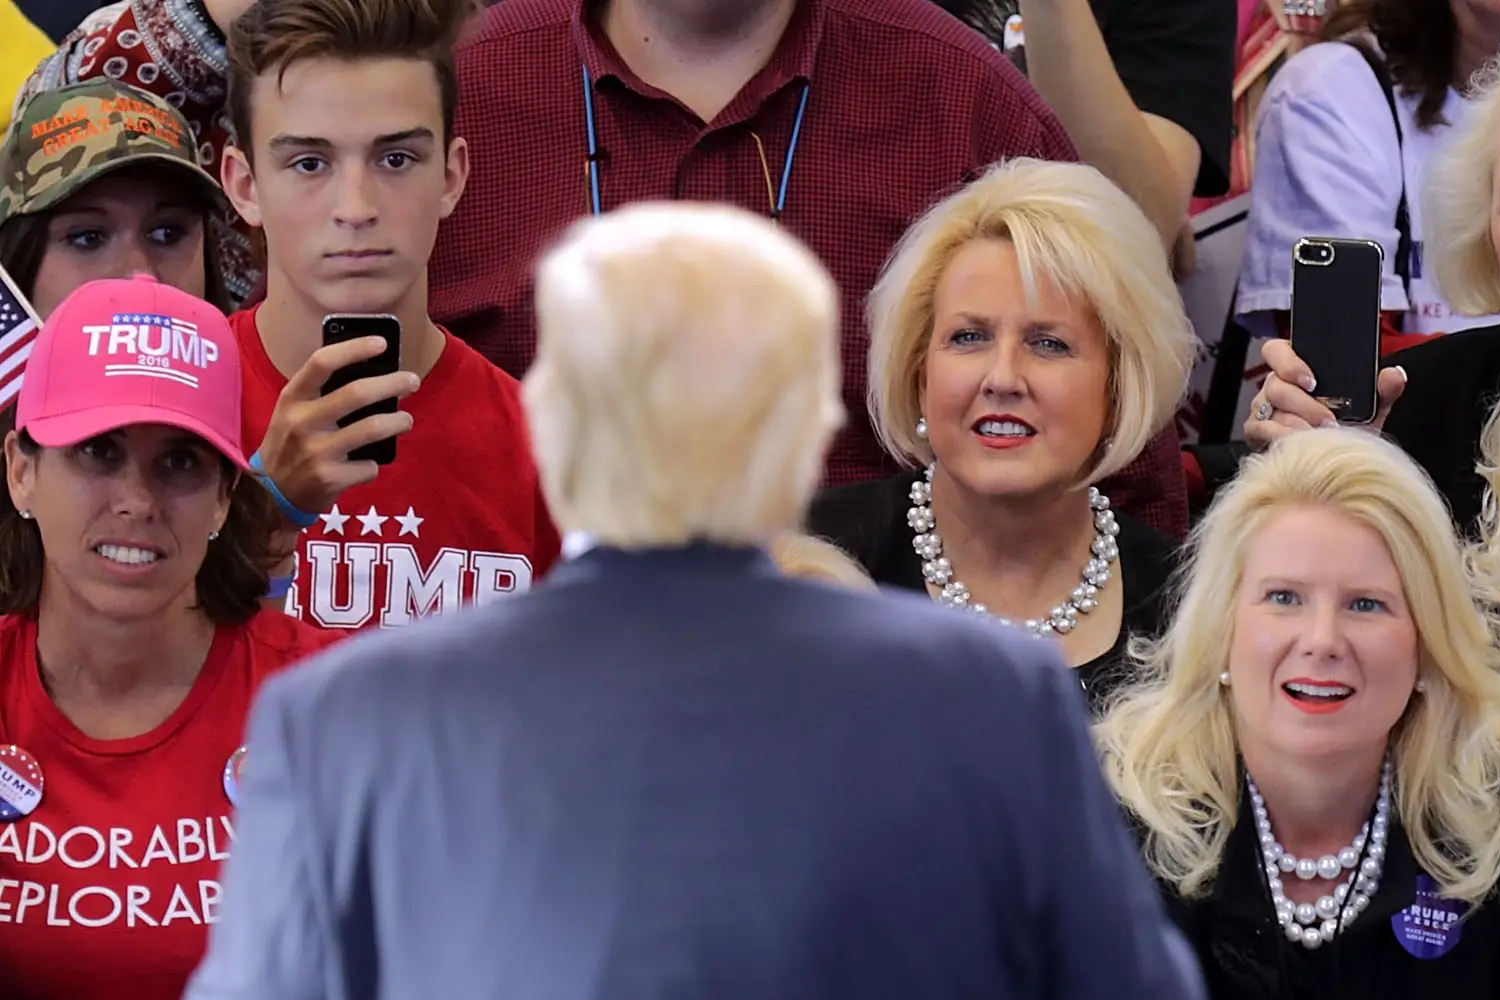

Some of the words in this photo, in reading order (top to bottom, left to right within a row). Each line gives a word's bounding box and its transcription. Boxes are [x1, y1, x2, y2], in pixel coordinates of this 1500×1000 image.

[31, 105, 89, 139] MAKE
[42, 118, 110, 156] GREAT
[82, 323, 219, 369] TRUMP
[138, 354, 170, 368] 2016
[285, 540, 533, 629] UMP
[0, 766, 36, 797] UMP
[1403, 915, 1450, 931] PENCE
